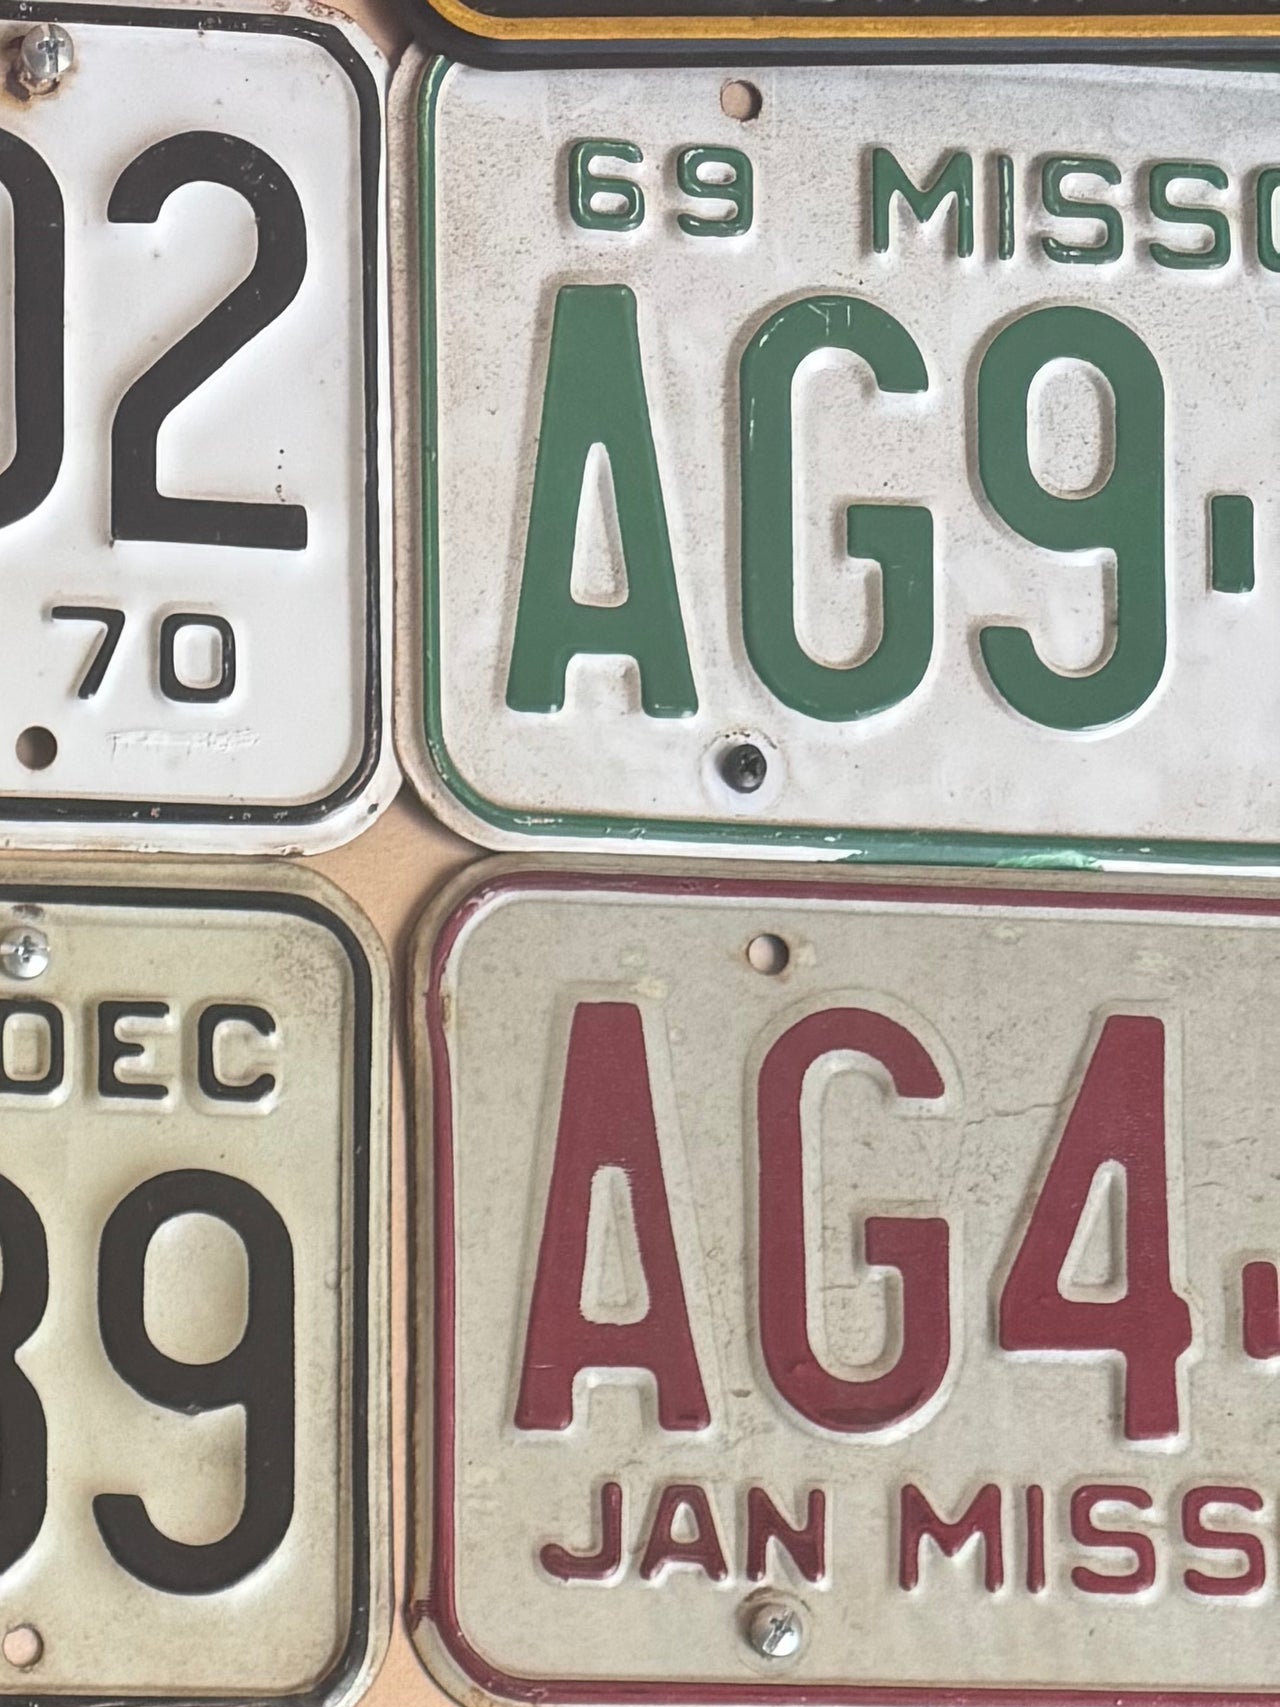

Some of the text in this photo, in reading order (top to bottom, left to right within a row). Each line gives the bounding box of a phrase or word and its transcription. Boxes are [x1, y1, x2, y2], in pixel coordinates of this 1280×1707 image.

[568, 139, 1280, 273] 69 MISS
[51, 606, 237, 703] 70
[539, 1481, 1280, 1596] JAN MISS
